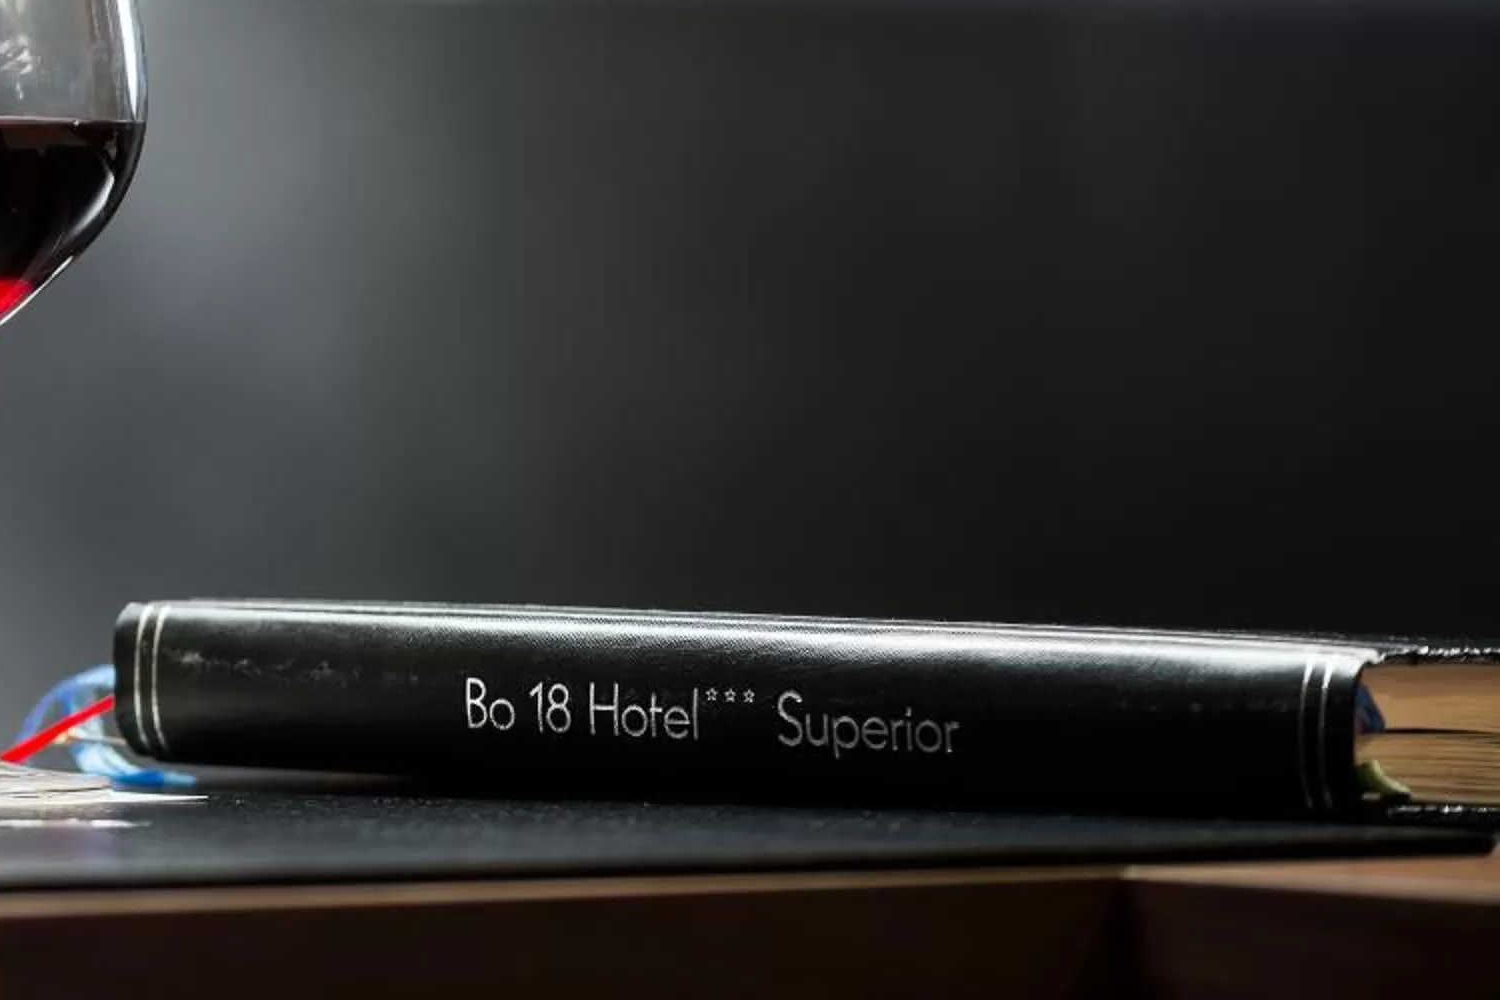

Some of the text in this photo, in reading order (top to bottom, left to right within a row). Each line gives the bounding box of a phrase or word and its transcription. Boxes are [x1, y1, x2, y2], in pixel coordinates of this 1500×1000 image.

[465, 677, 516, 730] Bo
[529, 681, 572, 734] 18
[777, 689, 961, 760] Superior
